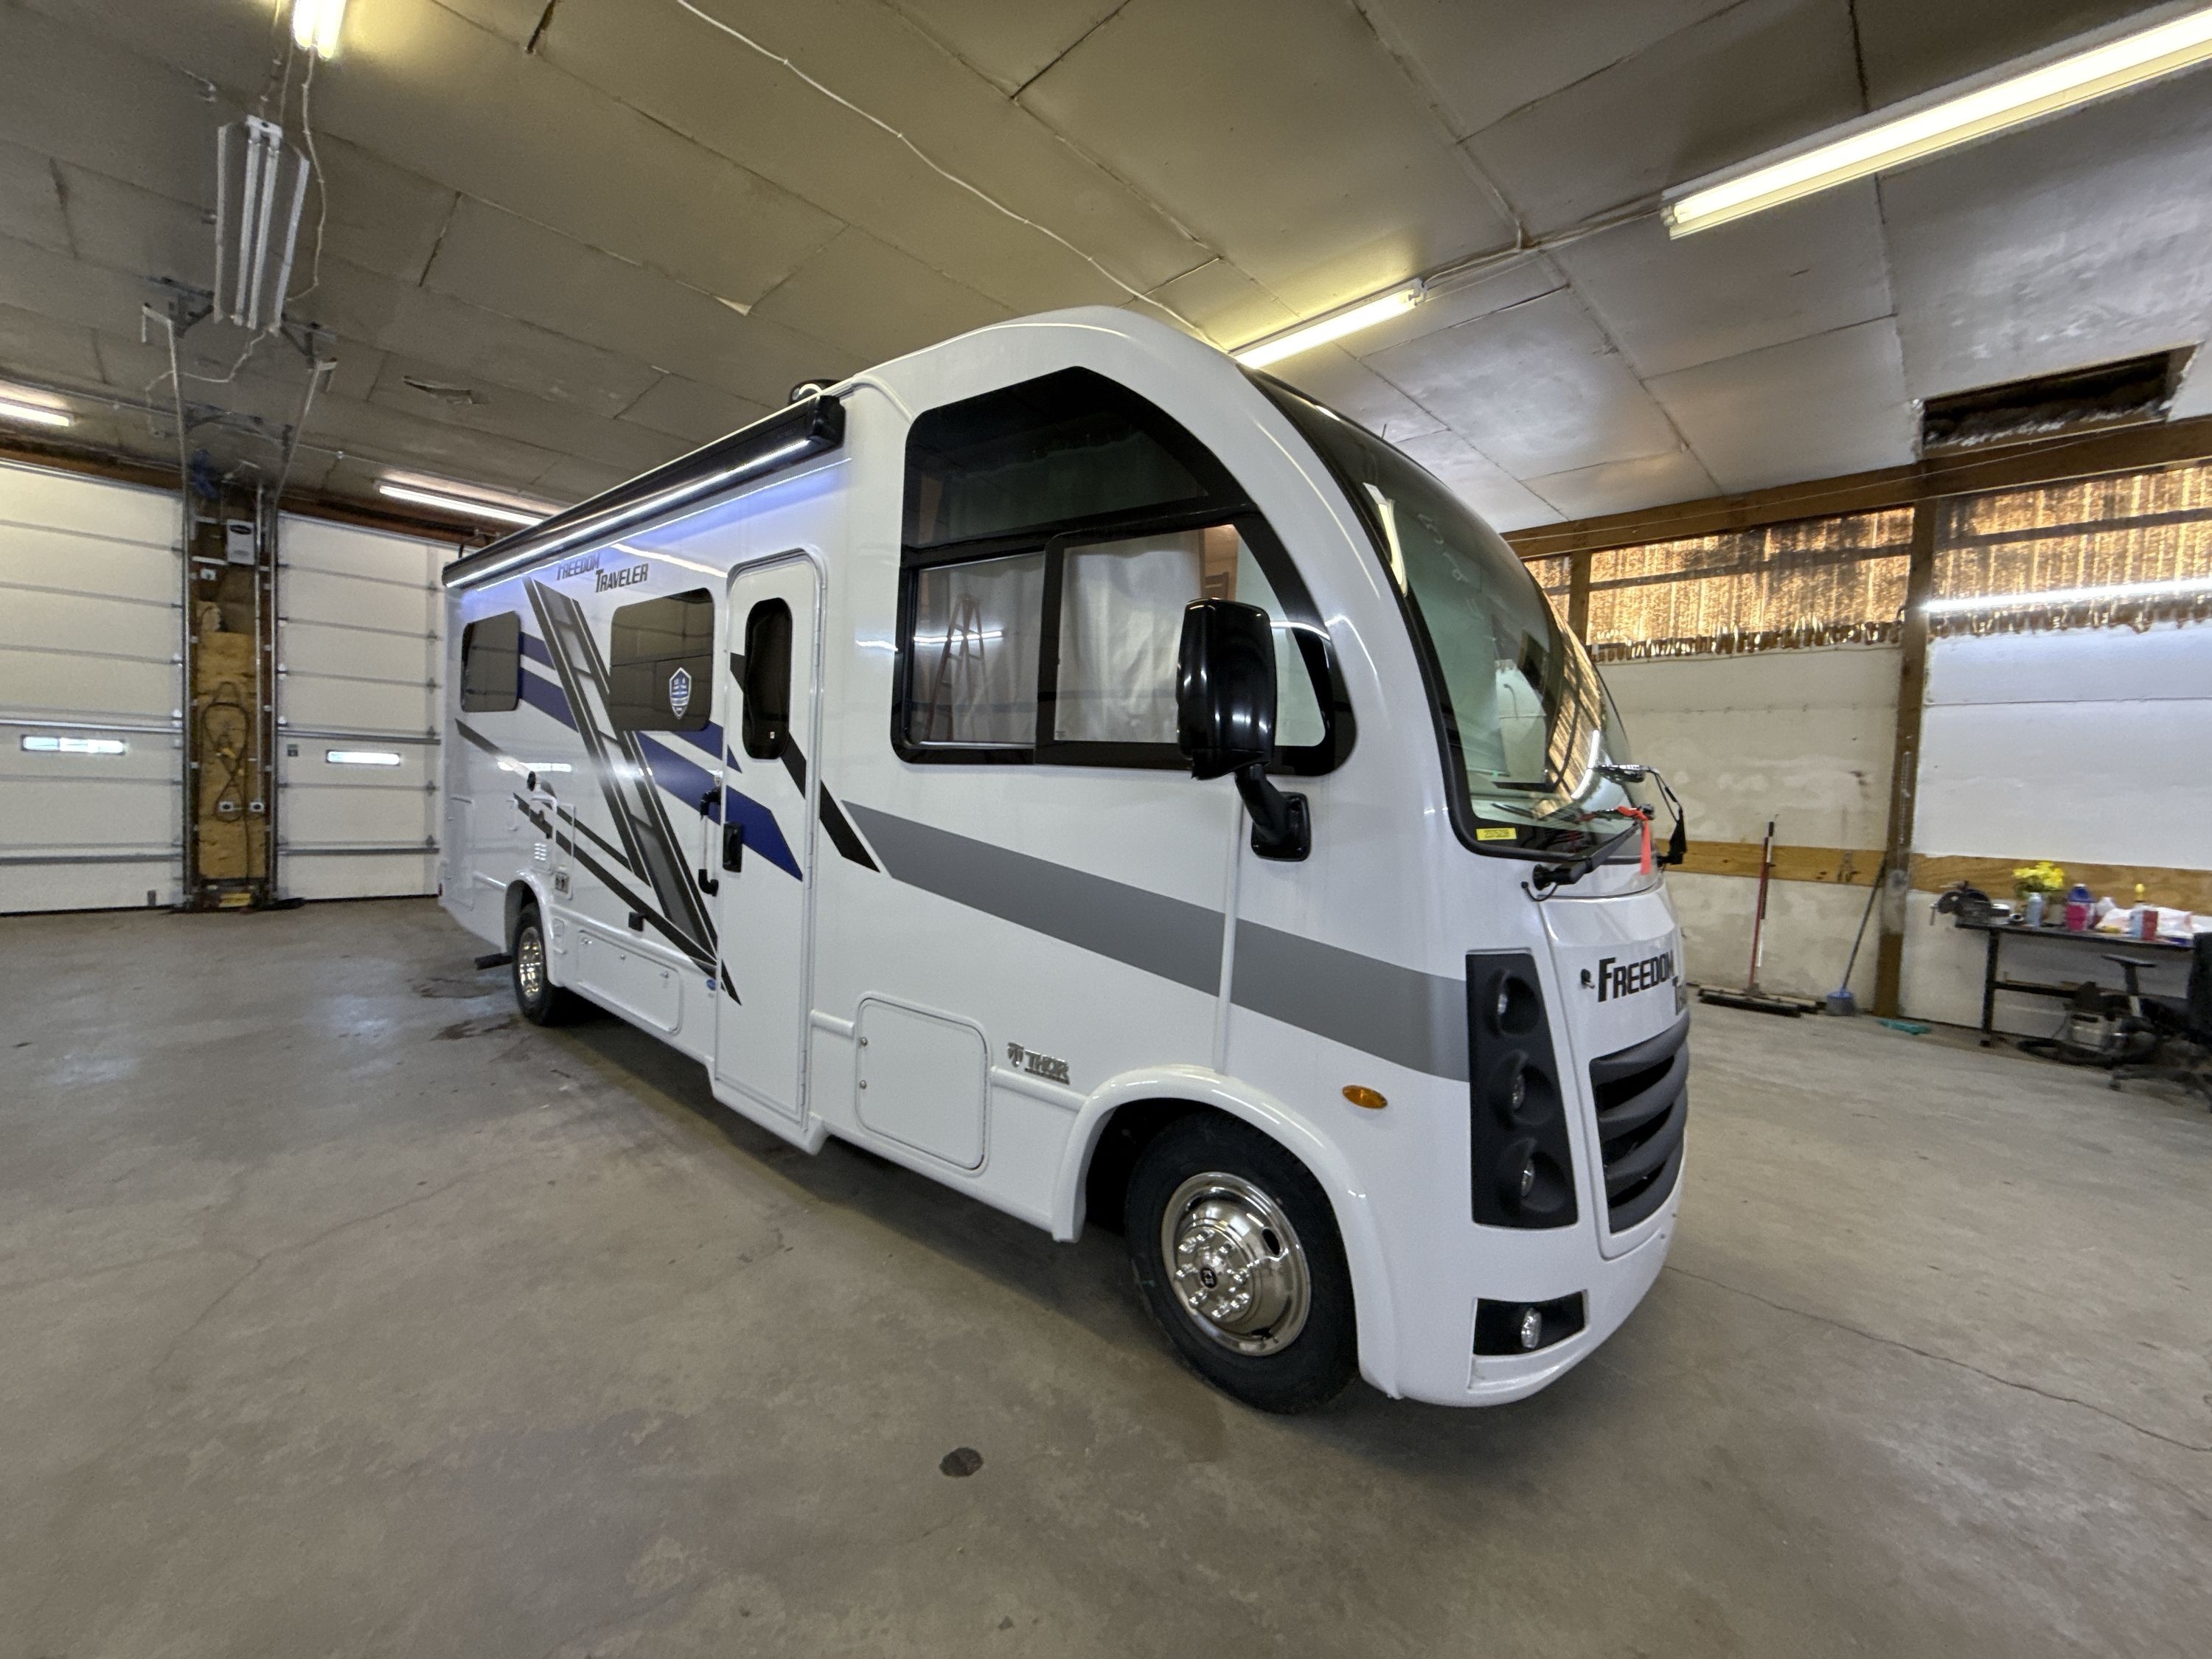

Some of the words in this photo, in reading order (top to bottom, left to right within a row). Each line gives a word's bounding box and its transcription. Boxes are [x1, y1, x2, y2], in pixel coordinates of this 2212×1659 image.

[557, 553, 601, 581] FREEDOM
[595, 563, 649, 593] TRAVELER
[1598, 949, 1674, 1003] FREEDOM
[1023, 1049, 1069, 1079] THOR
